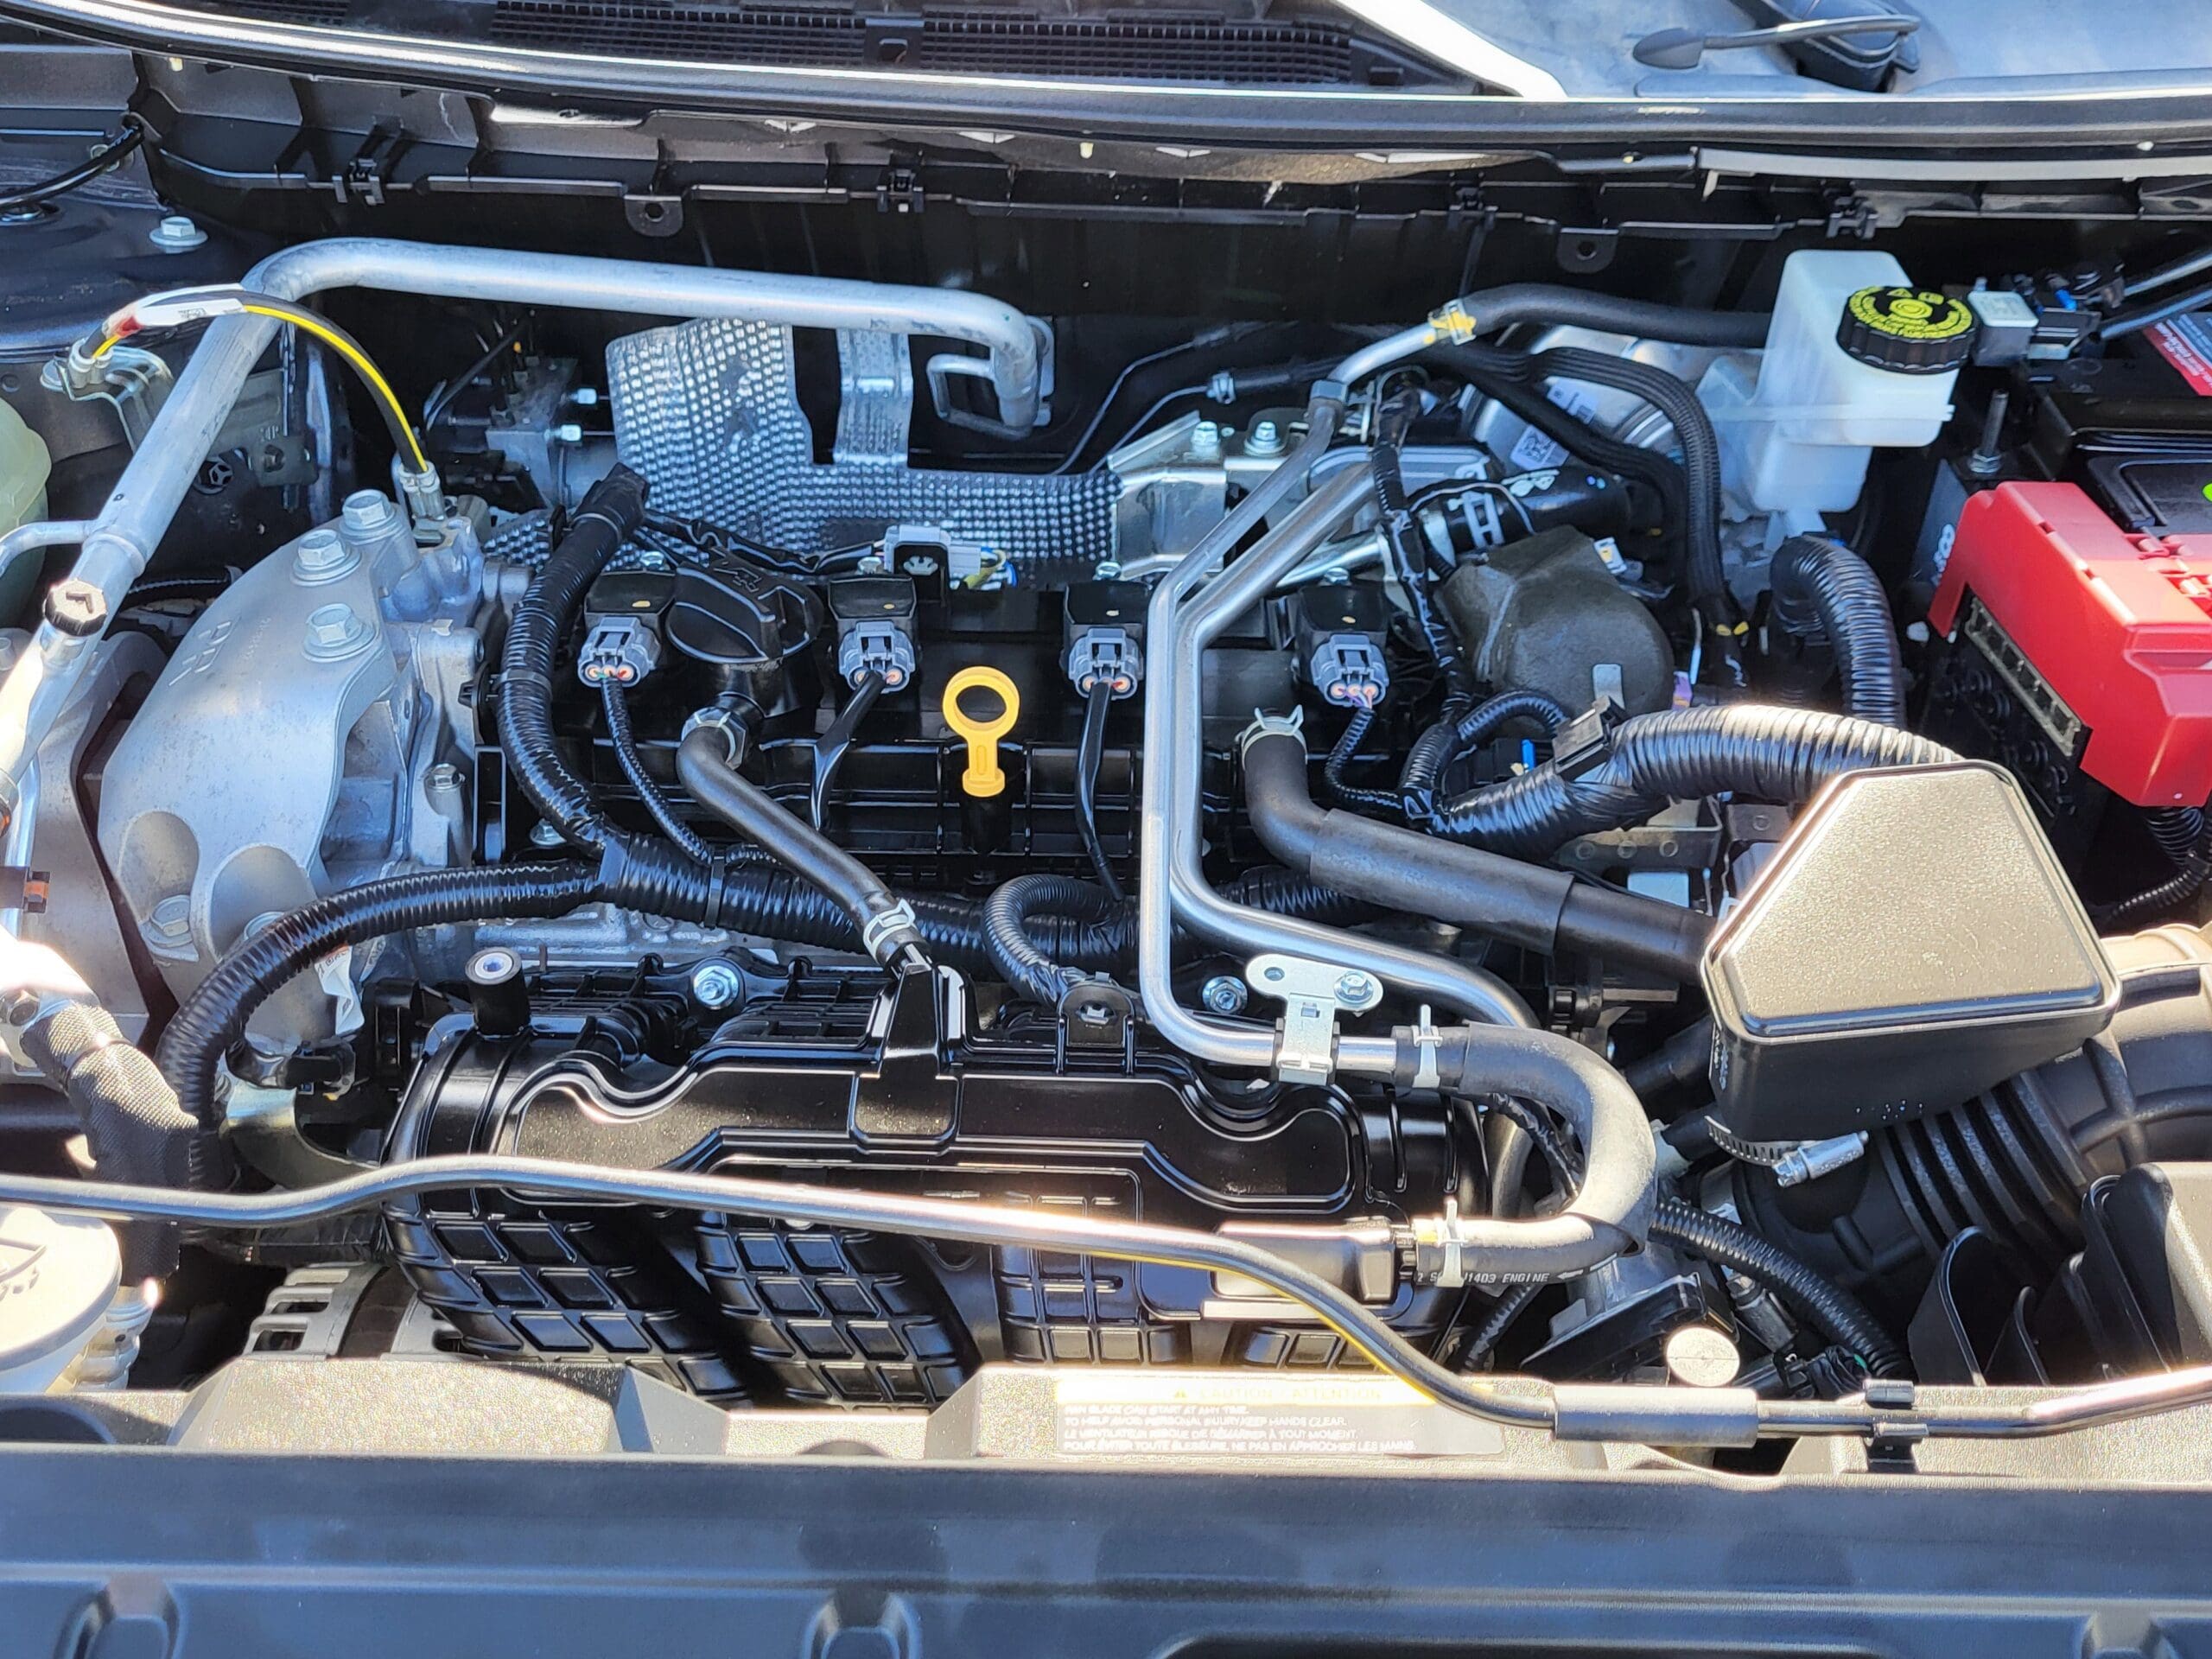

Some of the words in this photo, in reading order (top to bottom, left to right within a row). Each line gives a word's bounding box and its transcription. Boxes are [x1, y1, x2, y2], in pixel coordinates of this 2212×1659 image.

[1502, 1273, 1550, 1283] ENGINE
[1184, 1406, 1197, 1414] AT
[1065, 1416, 1079, 1426] TO
[1269, 1417, 1306, 1427] HANDS
[1308, 1417, 1348, 1427] CLEAR.
[1192, 1429, 1208, 1439] DE
[1279, 1429, 1306, 1439] TOUT
[1134, 1441, 1171, 1451] TOUTE
[1231, 1442, 1247, 1452] NE
[1248, 1441, 1270, 1452] PAS
[1271, 1442, 1287, 1452] EN
[1357, 1441, 1377, 1452] LES
